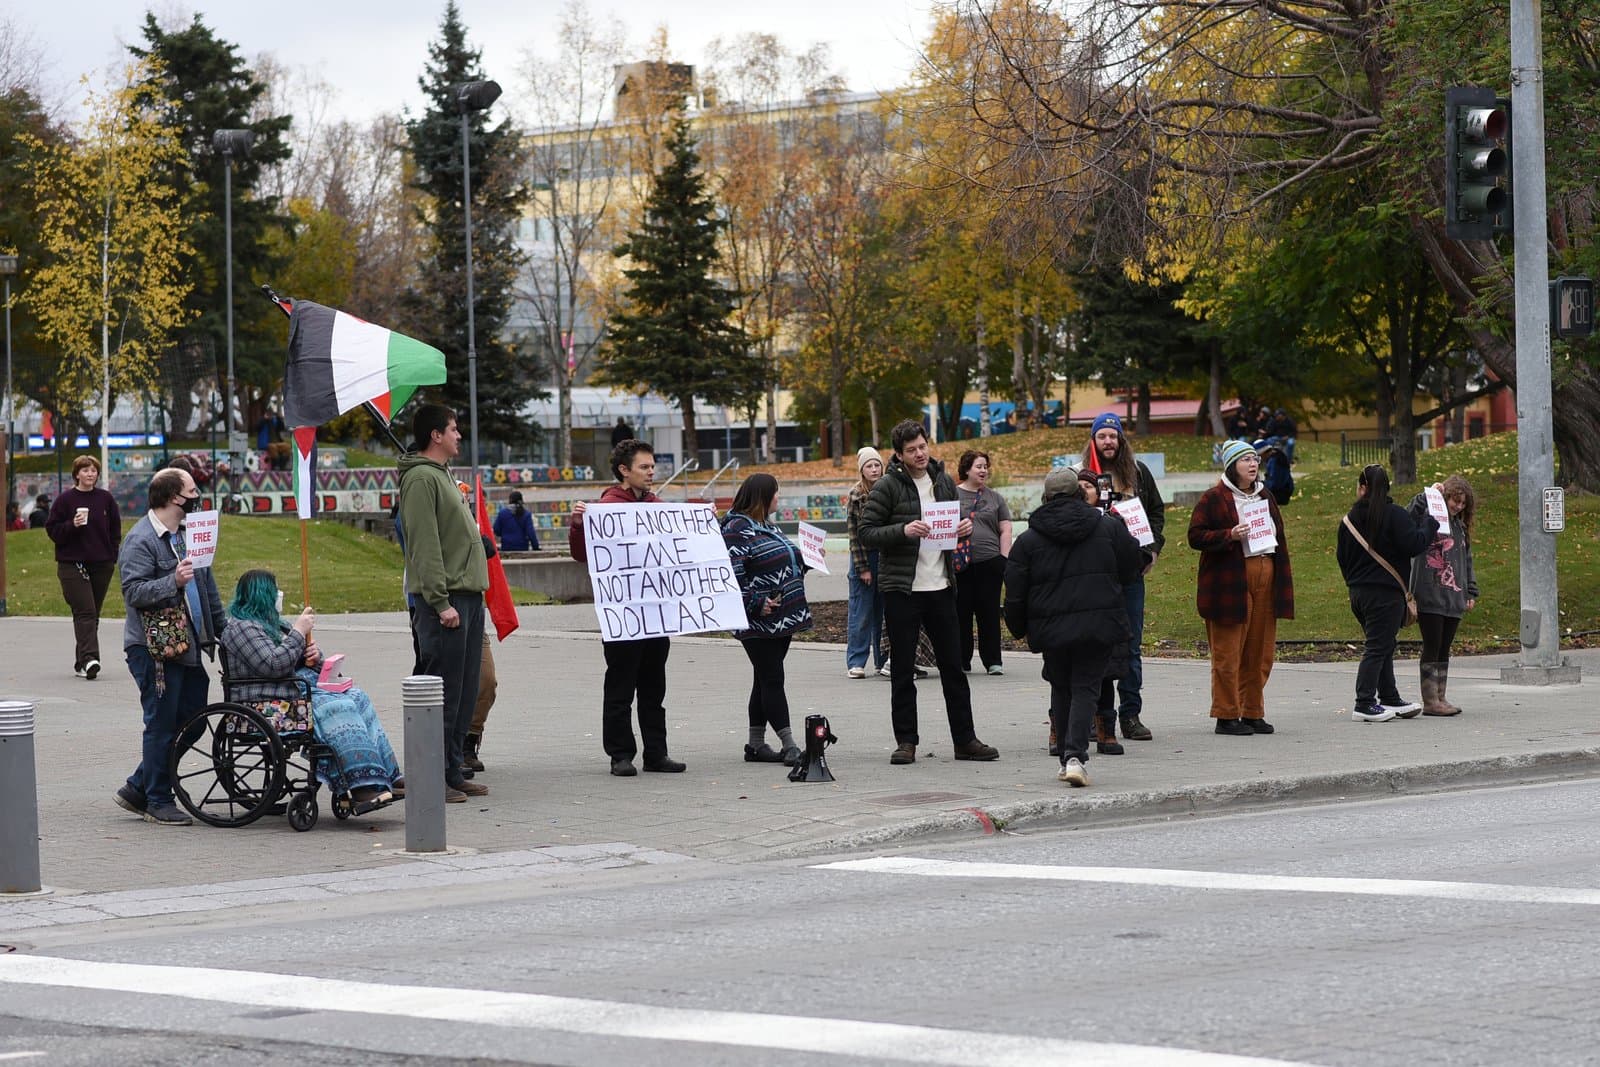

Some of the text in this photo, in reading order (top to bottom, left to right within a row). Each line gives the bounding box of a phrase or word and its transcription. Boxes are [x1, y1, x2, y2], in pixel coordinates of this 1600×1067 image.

[588, 507, 721, 540] NOT ANOTHER
[932, 519, 953, 529] FREE
[1126, 515, 1140, 526] REE
[1250, 517, 1265, 529] FREE
[192, 531, 212, 543] FREE
[803, 540, 817, 551] FREE
[593, 538, 693, 573] DIME
[597, 566, 738, 603] NOT ANOTHER
[603, 596, 720, 638] DOLLAR
